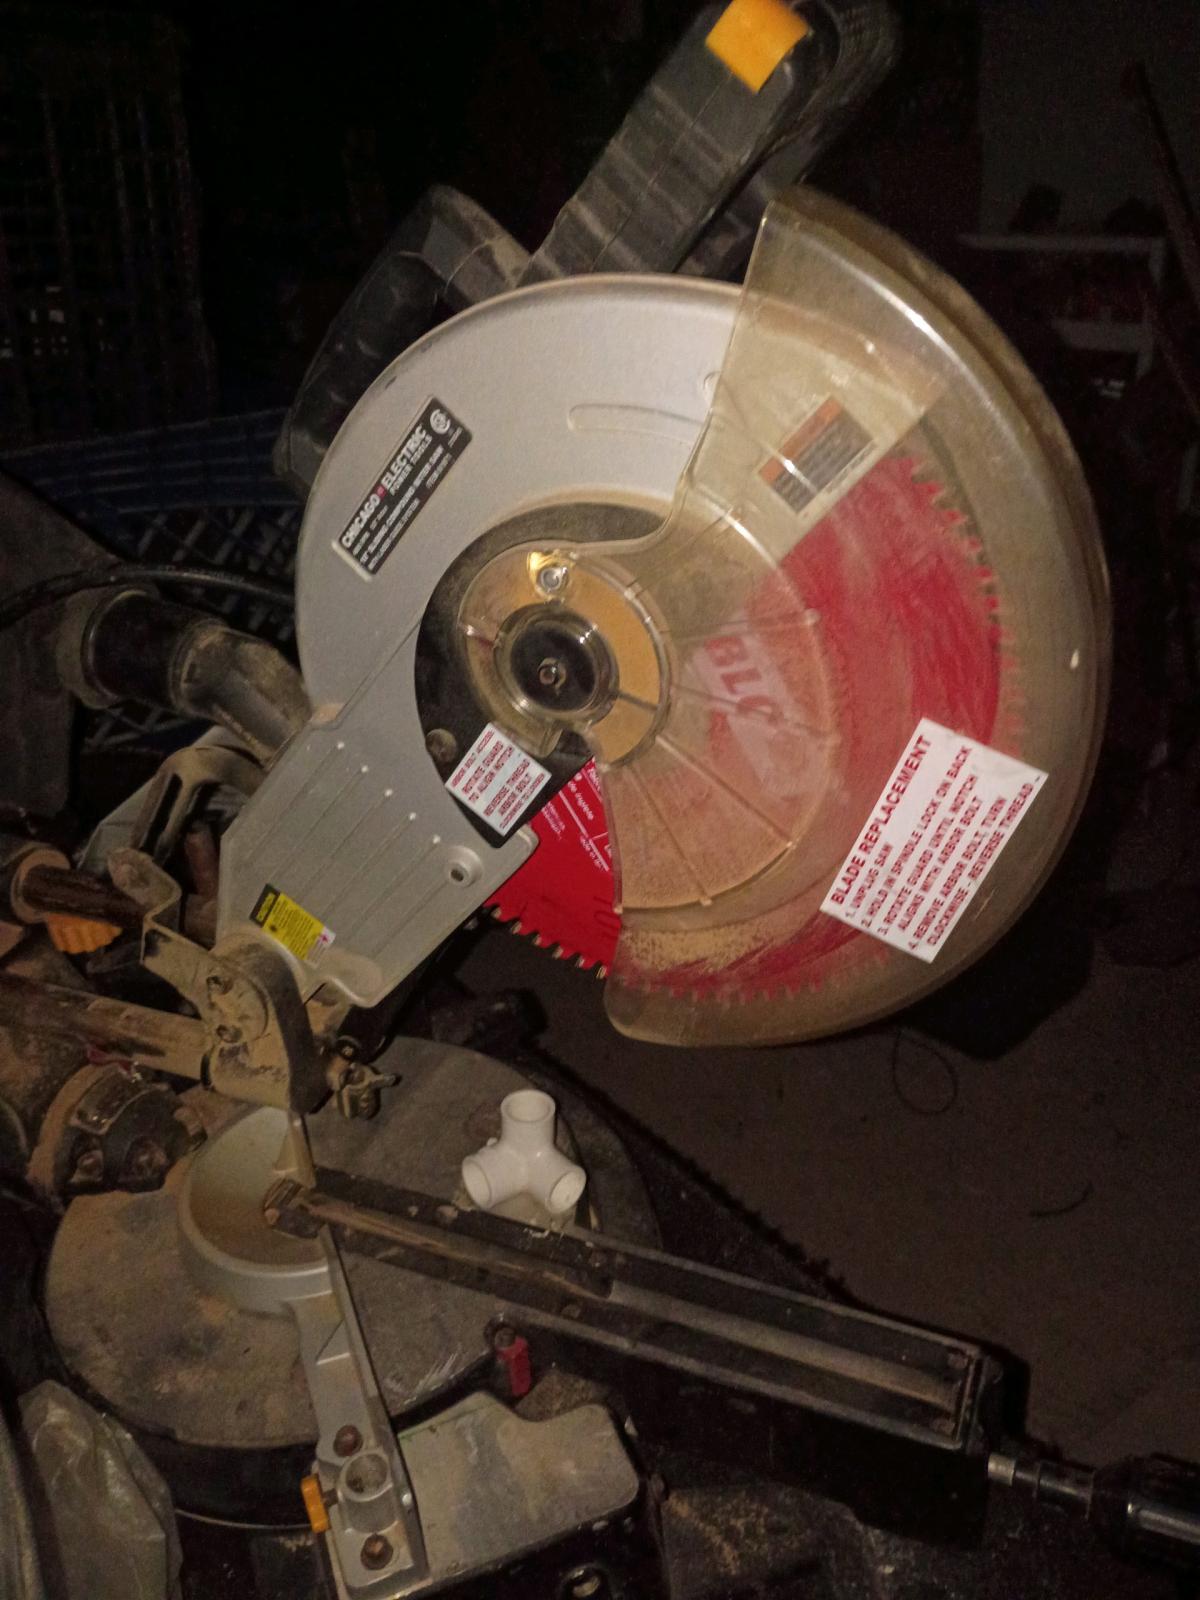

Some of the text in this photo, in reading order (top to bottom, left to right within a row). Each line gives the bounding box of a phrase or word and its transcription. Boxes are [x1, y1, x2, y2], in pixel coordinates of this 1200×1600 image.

[339, 491, 381, 549] CHICAGO
[379, 423, 428, 490] ELECTRIC
[461, 739, 504, 795] ROTATE GUARD
[468, 790, 479, 804] TO
[492, 744, 514, 772] NOTCH
[483, 758, 530, 817] REVERSE THREAD
[497, 772, 532, 816] ARBOR BOLT
[830, 734, 932, 905] BLADE REPLACEMENT
[866, 888, 889, 918] HOLD
[882, 874, 897, 889] IN
[890, 829, 923, 876] SPINDLE
[916, 798, 941, 830] LOCK
[934, 778, 952, 799] ON
[945, 744, 972, 779] BACK
[849, 867, 879, 910] UNPLUG
[873, 842, 893, 868] SAW
[883, 885, 913, 926] ROTATE
[906, 848, 935, 886] GUARD
[928, 814, 954, 849] UNTIL
[948, 772, 979, 815] NOTCH
[897, 795, 984, 932] ALIGNS WITH ARBOR BOLT
[912, 897, 944, 941] REMOVE
[938, 860, 967, 898] ARBOR
[980, 795, 1007, 829] TURN
[925, 886, 968, 947] CLOCKWISE
[966, 829, 1004, 880] REVERSE
[997, 781, 1035, 831] THREAD
